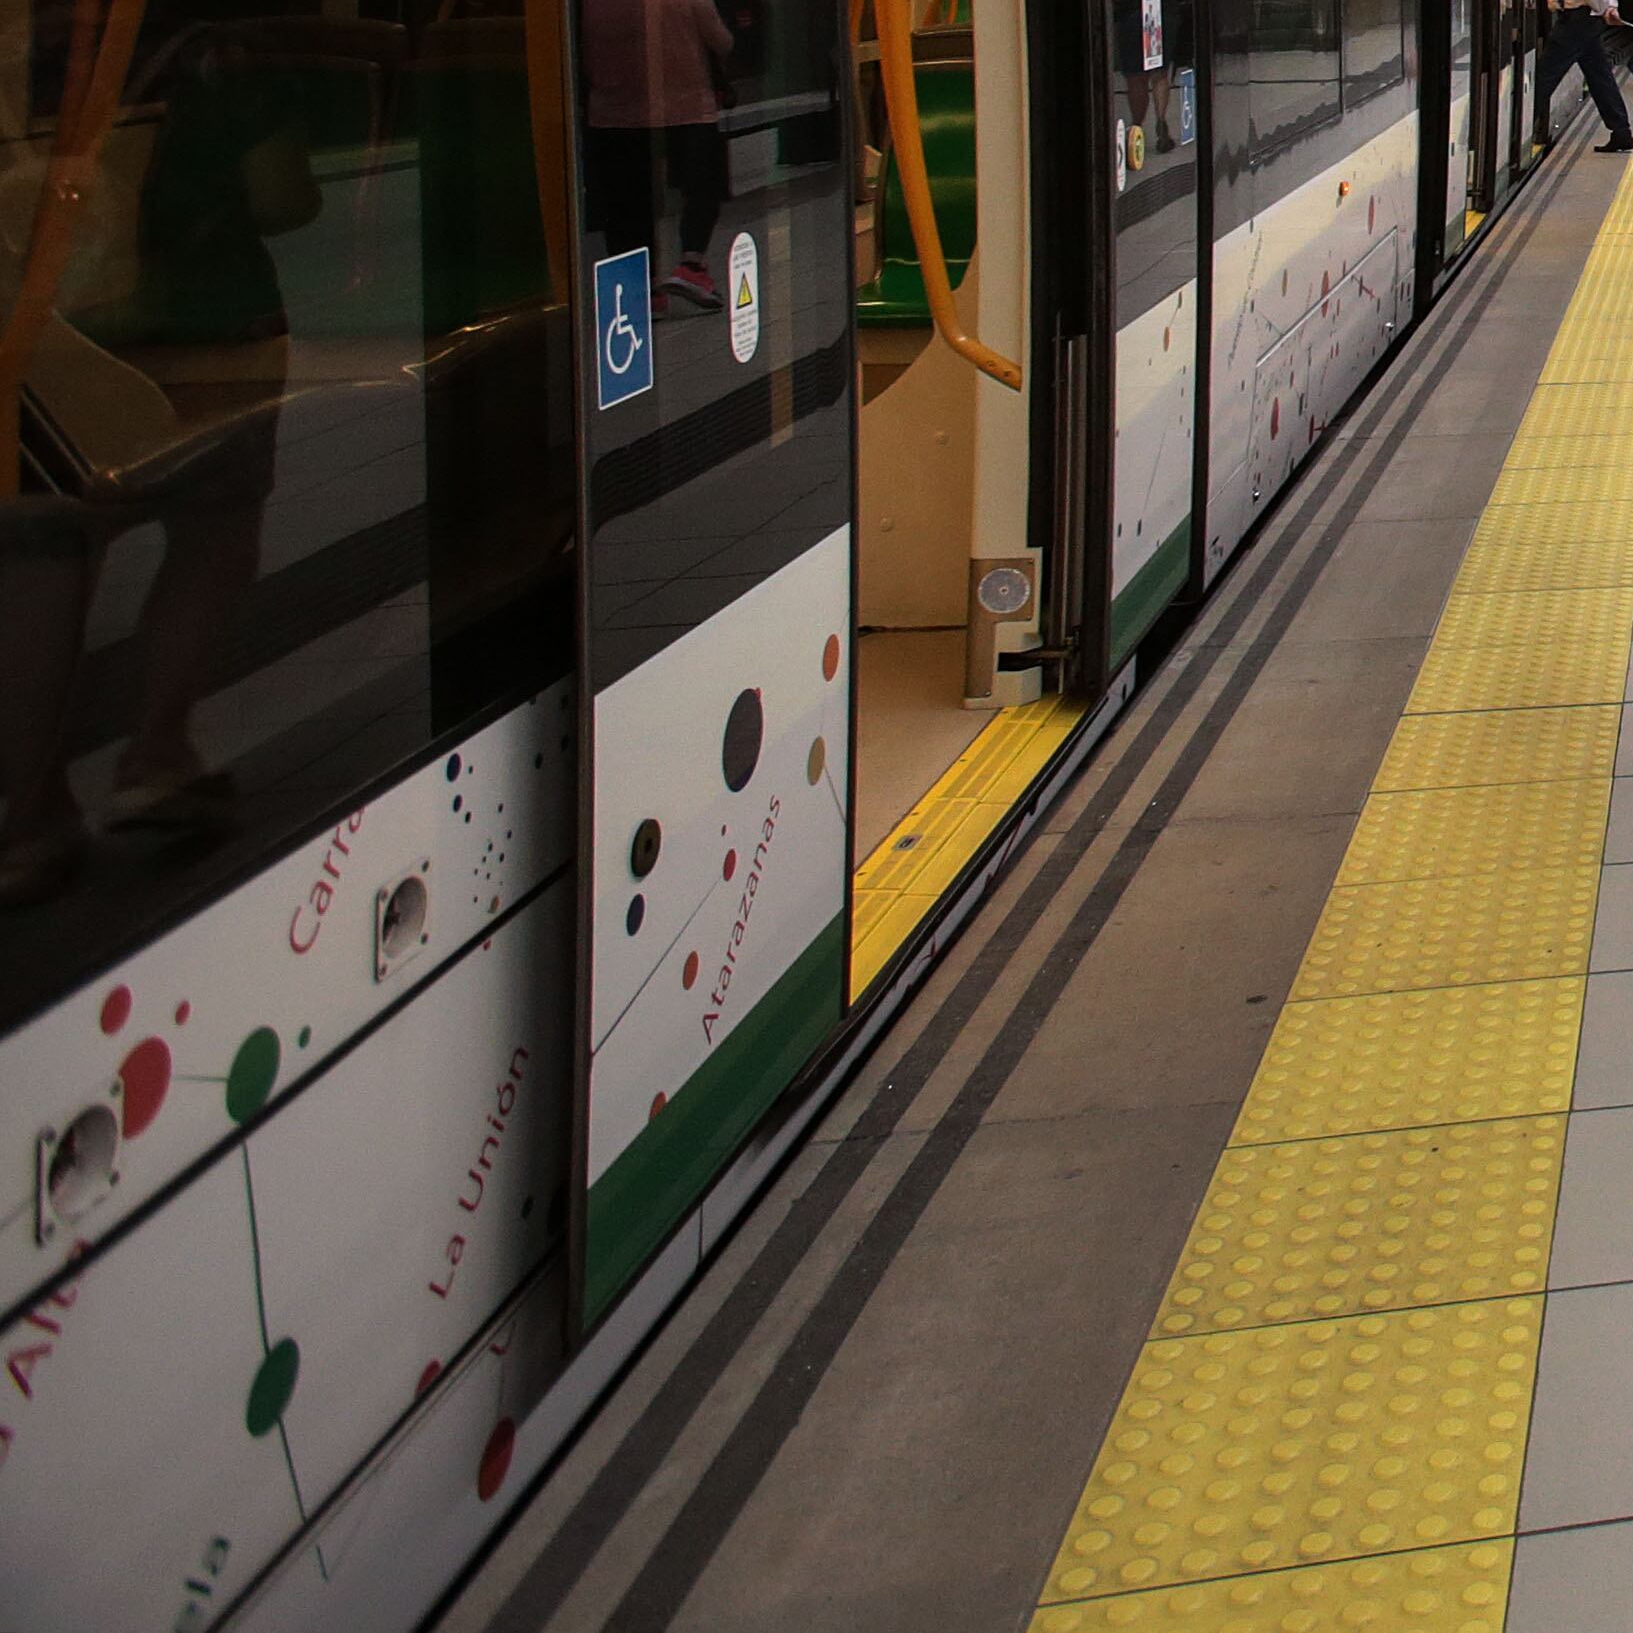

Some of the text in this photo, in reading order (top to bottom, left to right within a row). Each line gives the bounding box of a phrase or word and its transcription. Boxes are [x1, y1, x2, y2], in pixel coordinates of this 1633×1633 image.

[702, 794, 781, 1046] Atarazanas
[428, 1046, 530, 1299] La Unión
